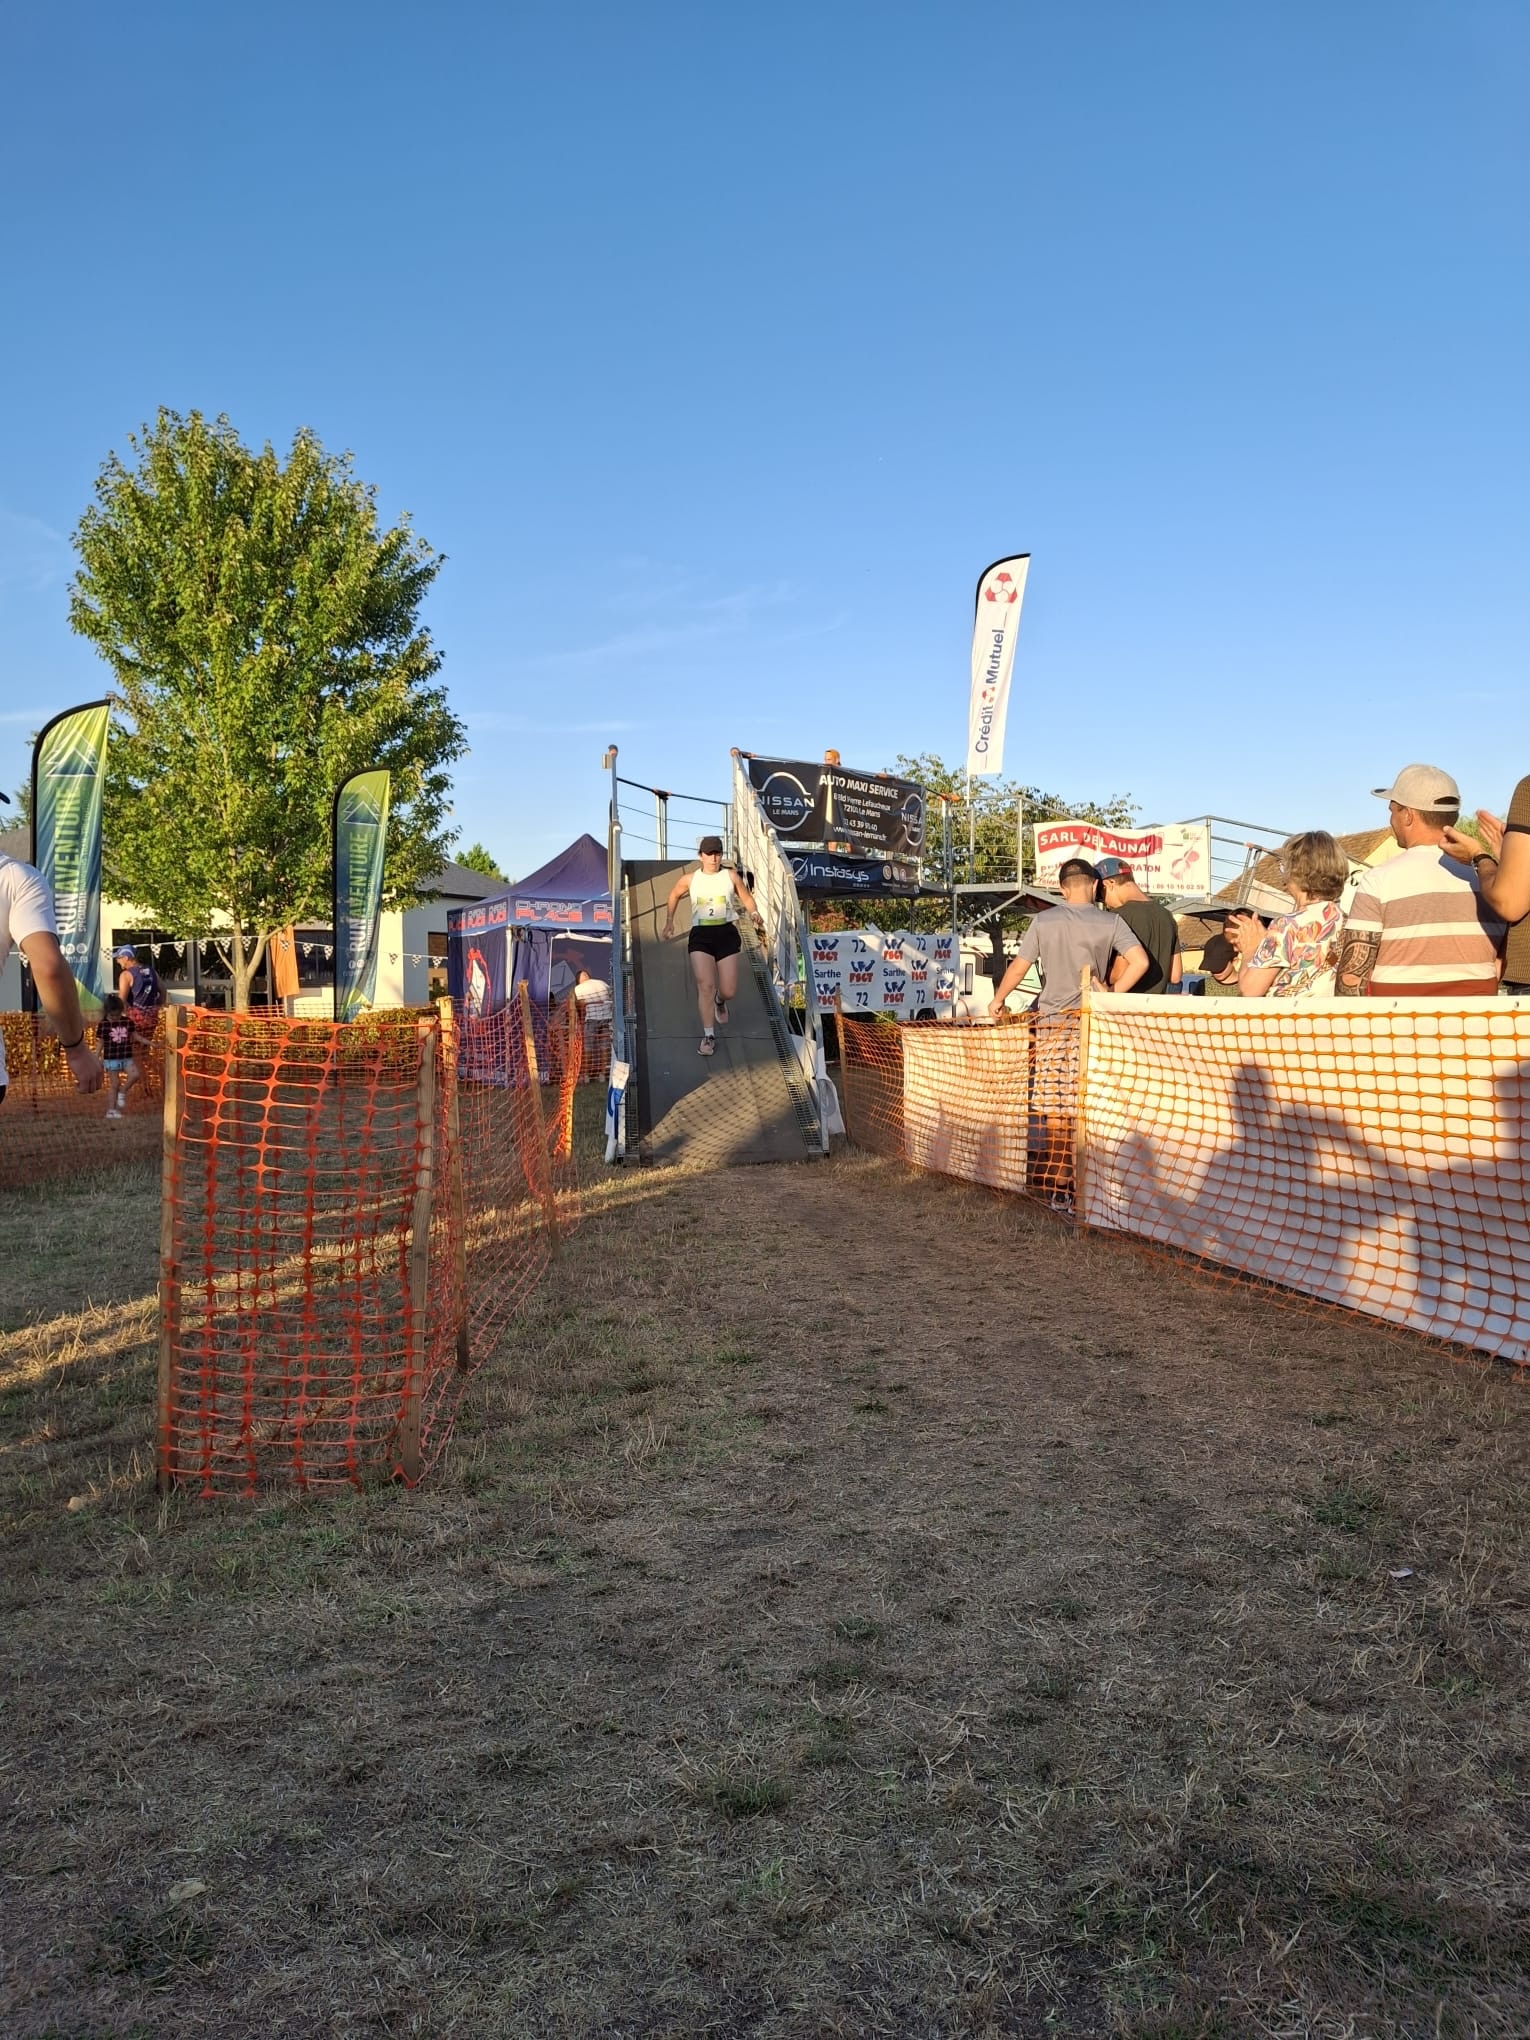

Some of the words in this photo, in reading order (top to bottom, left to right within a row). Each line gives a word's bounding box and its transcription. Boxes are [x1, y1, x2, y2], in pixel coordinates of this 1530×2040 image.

[975, 705, 994, 754] Crédit
[985, 629, 1005, 684] Mutuel
[819, 774, 846, 788] AUTO
[847, 778, 868, 793] MAXI
[869, 783, 899, 800] SERVICE
[756, 795, 815, 808] NISSAN
[1040, 831, 1078, 846] SARL
[1083, 832, 1151, 854] DELAUNAY
[515, 900, 583, 912] CHRONO
[709, 908, 714, 917] 2
[515, 909, 583, 923] PLACE
[851, 939, 867, 953] 72
[916, 937, 927, 951] 72
[814, 969, 841, 979] Sarthe
[883, 968, 906, 978] Sarthe
[856, 991, 869, 1007] 72
[916, 989, 926, 1004] 72
